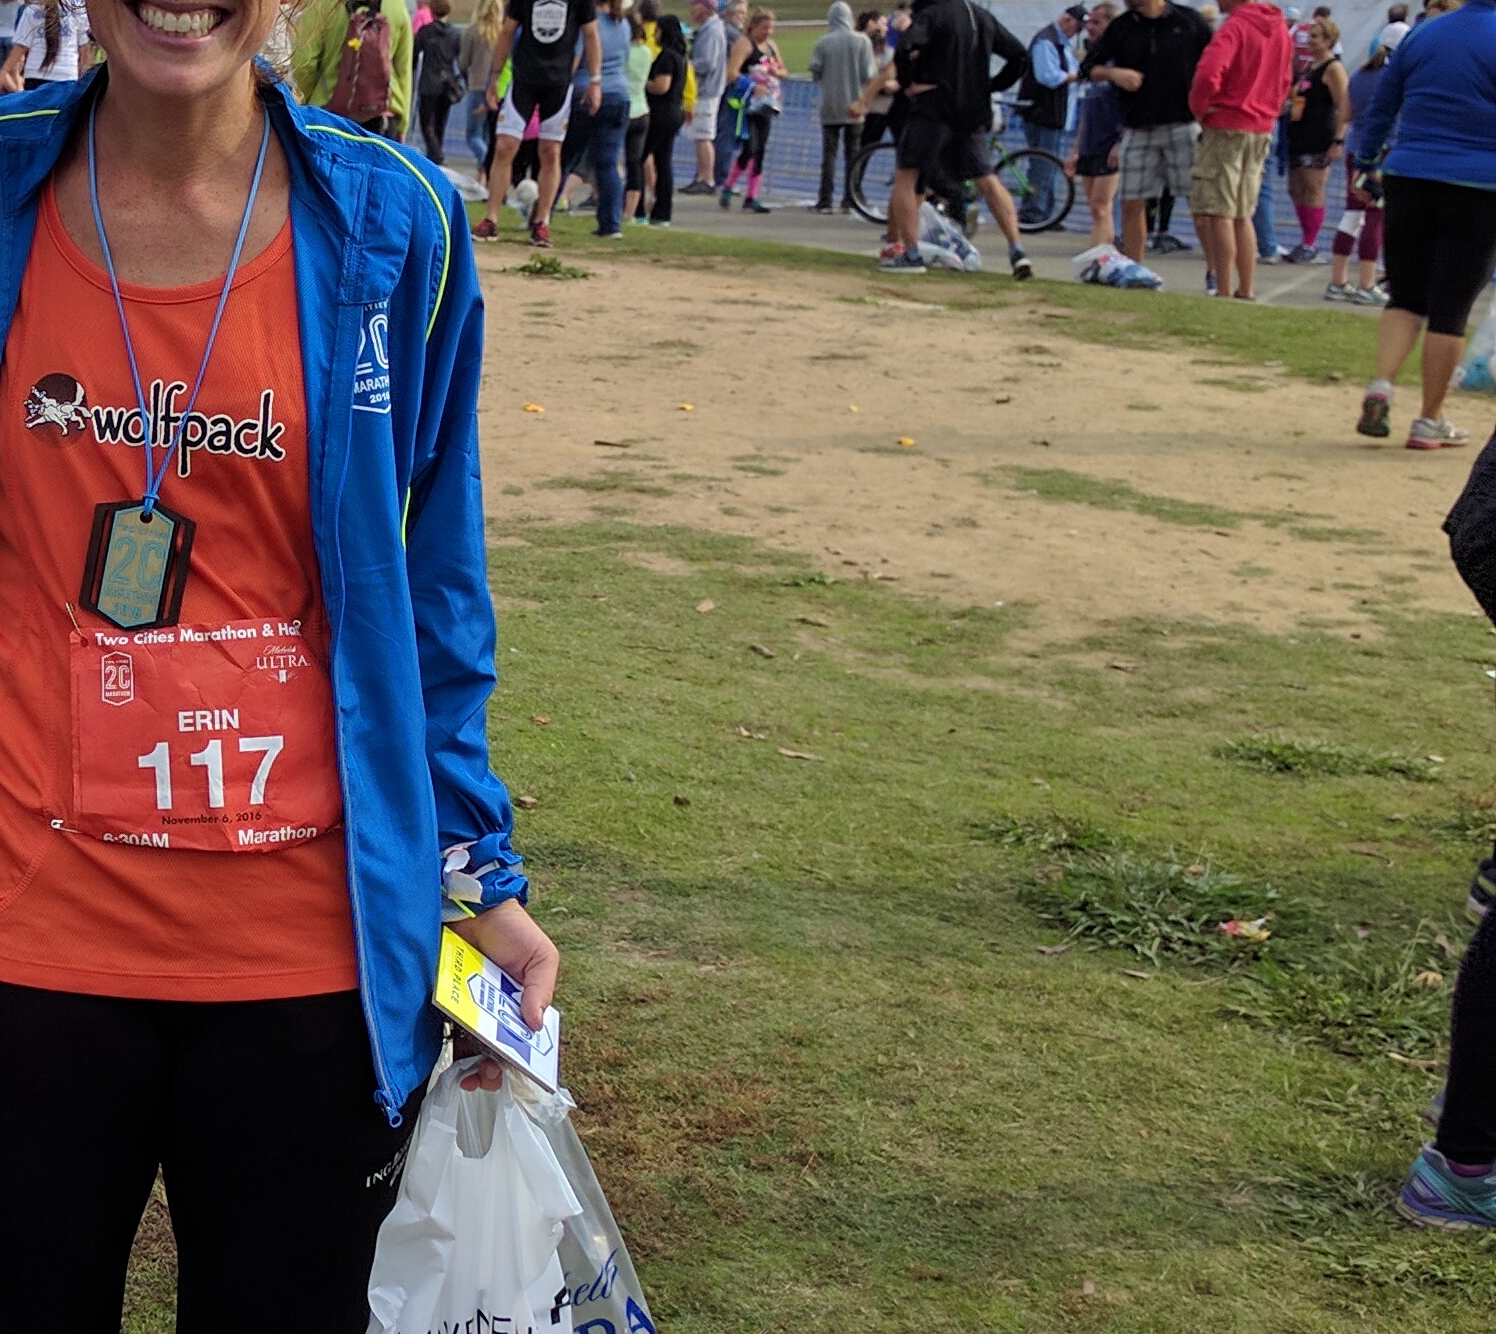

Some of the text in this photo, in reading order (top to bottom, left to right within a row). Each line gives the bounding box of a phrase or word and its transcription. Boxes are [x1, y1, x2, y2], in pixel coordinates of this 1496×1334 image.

[91, 379, 286, 478] wolfpack
[108, 534, 166, 591] 2C
[95, 632, 129, 646] Two
[133, 630, 175, 645] Cities
[179, 625, 256, 642] Marathon
[261, 623, 274, 638] &
[256, 655, 308, 670] ULTRA
[104, 665, 131, 690] 2C
[178, 709, 239, 732] ERIN
[137, 735, 285, 810] 117
[161, 811, 262, 825] November 6, 2016
[238, 826, 317, 846] Marathon
[454, 945, 465, 973] THIRD
